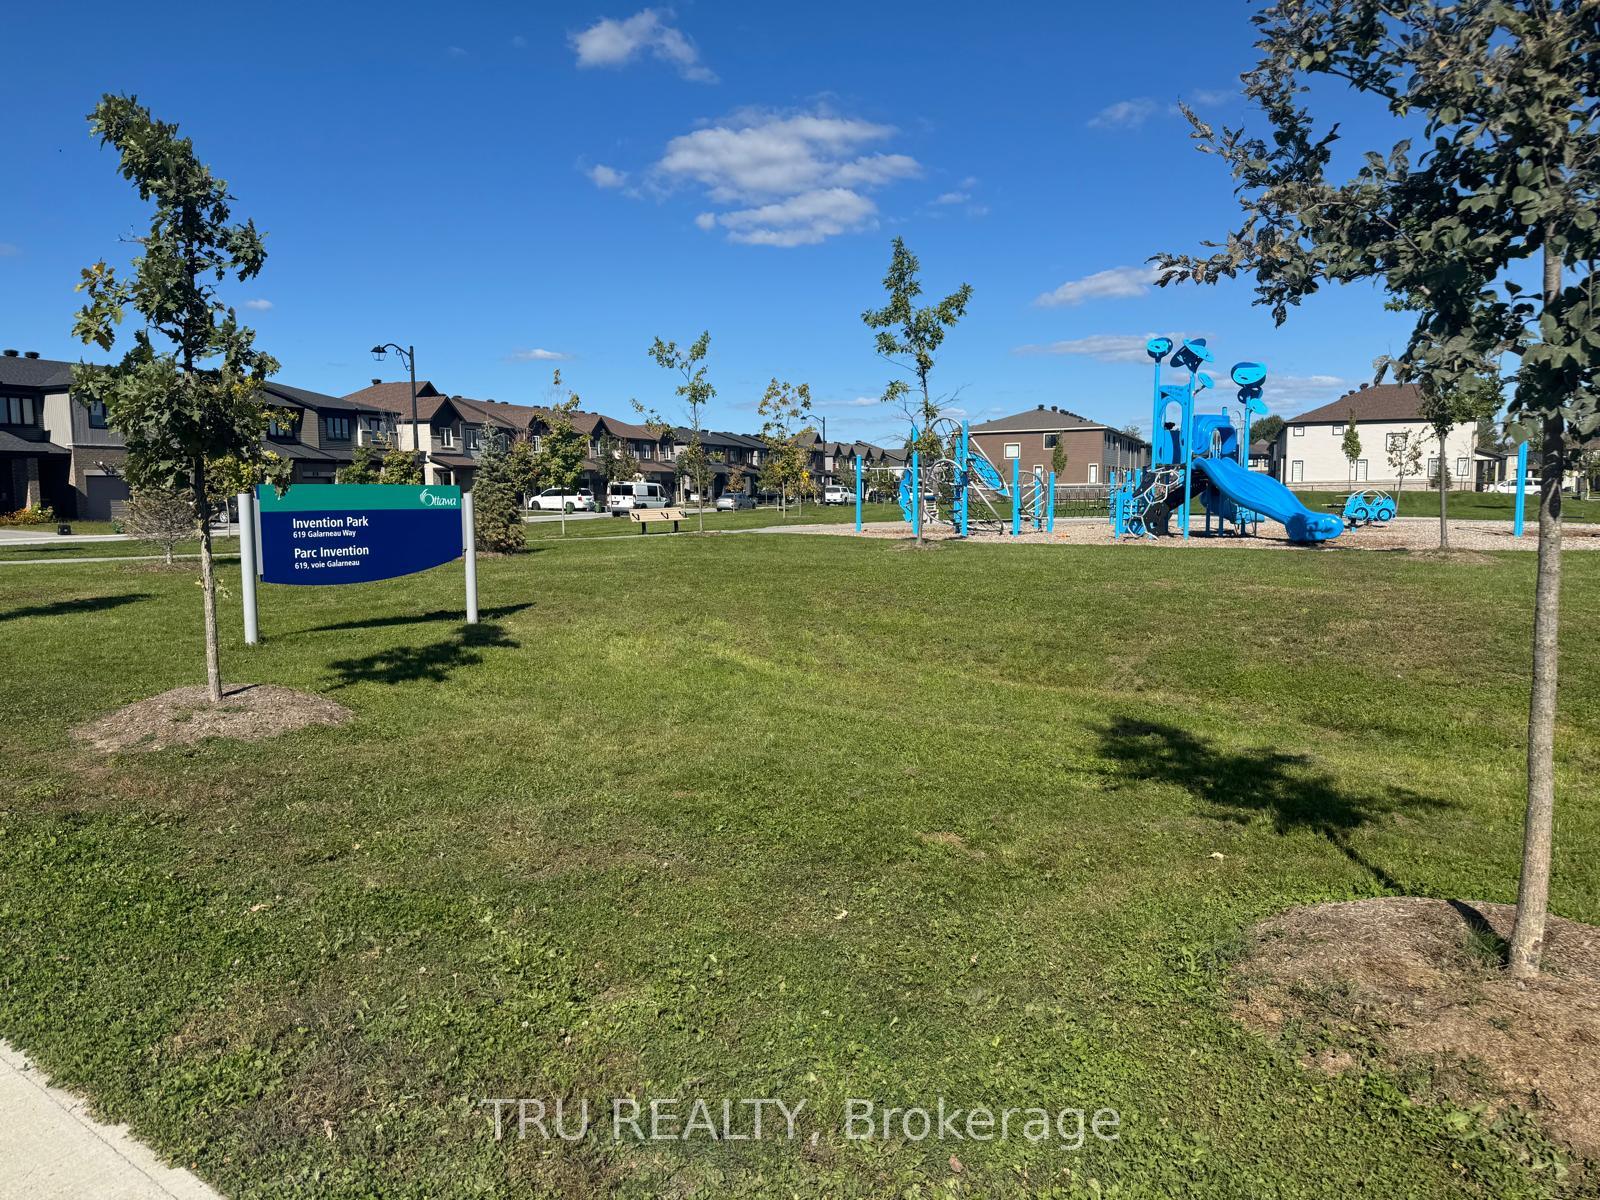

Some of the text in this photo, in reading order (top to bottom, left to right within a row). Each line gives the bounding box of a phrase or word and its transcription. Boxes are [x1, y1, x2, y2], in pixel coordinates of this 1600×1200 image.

[419, 488, 457, 506] Ottawa
[292, 516, 369, 529] Invention Park
[293, 529, 357, 539] 619 Galarneau Way
[294, 545, 369, 559] Parc Invention
[294, 559, 360, 571] 619, voie Galarneau
